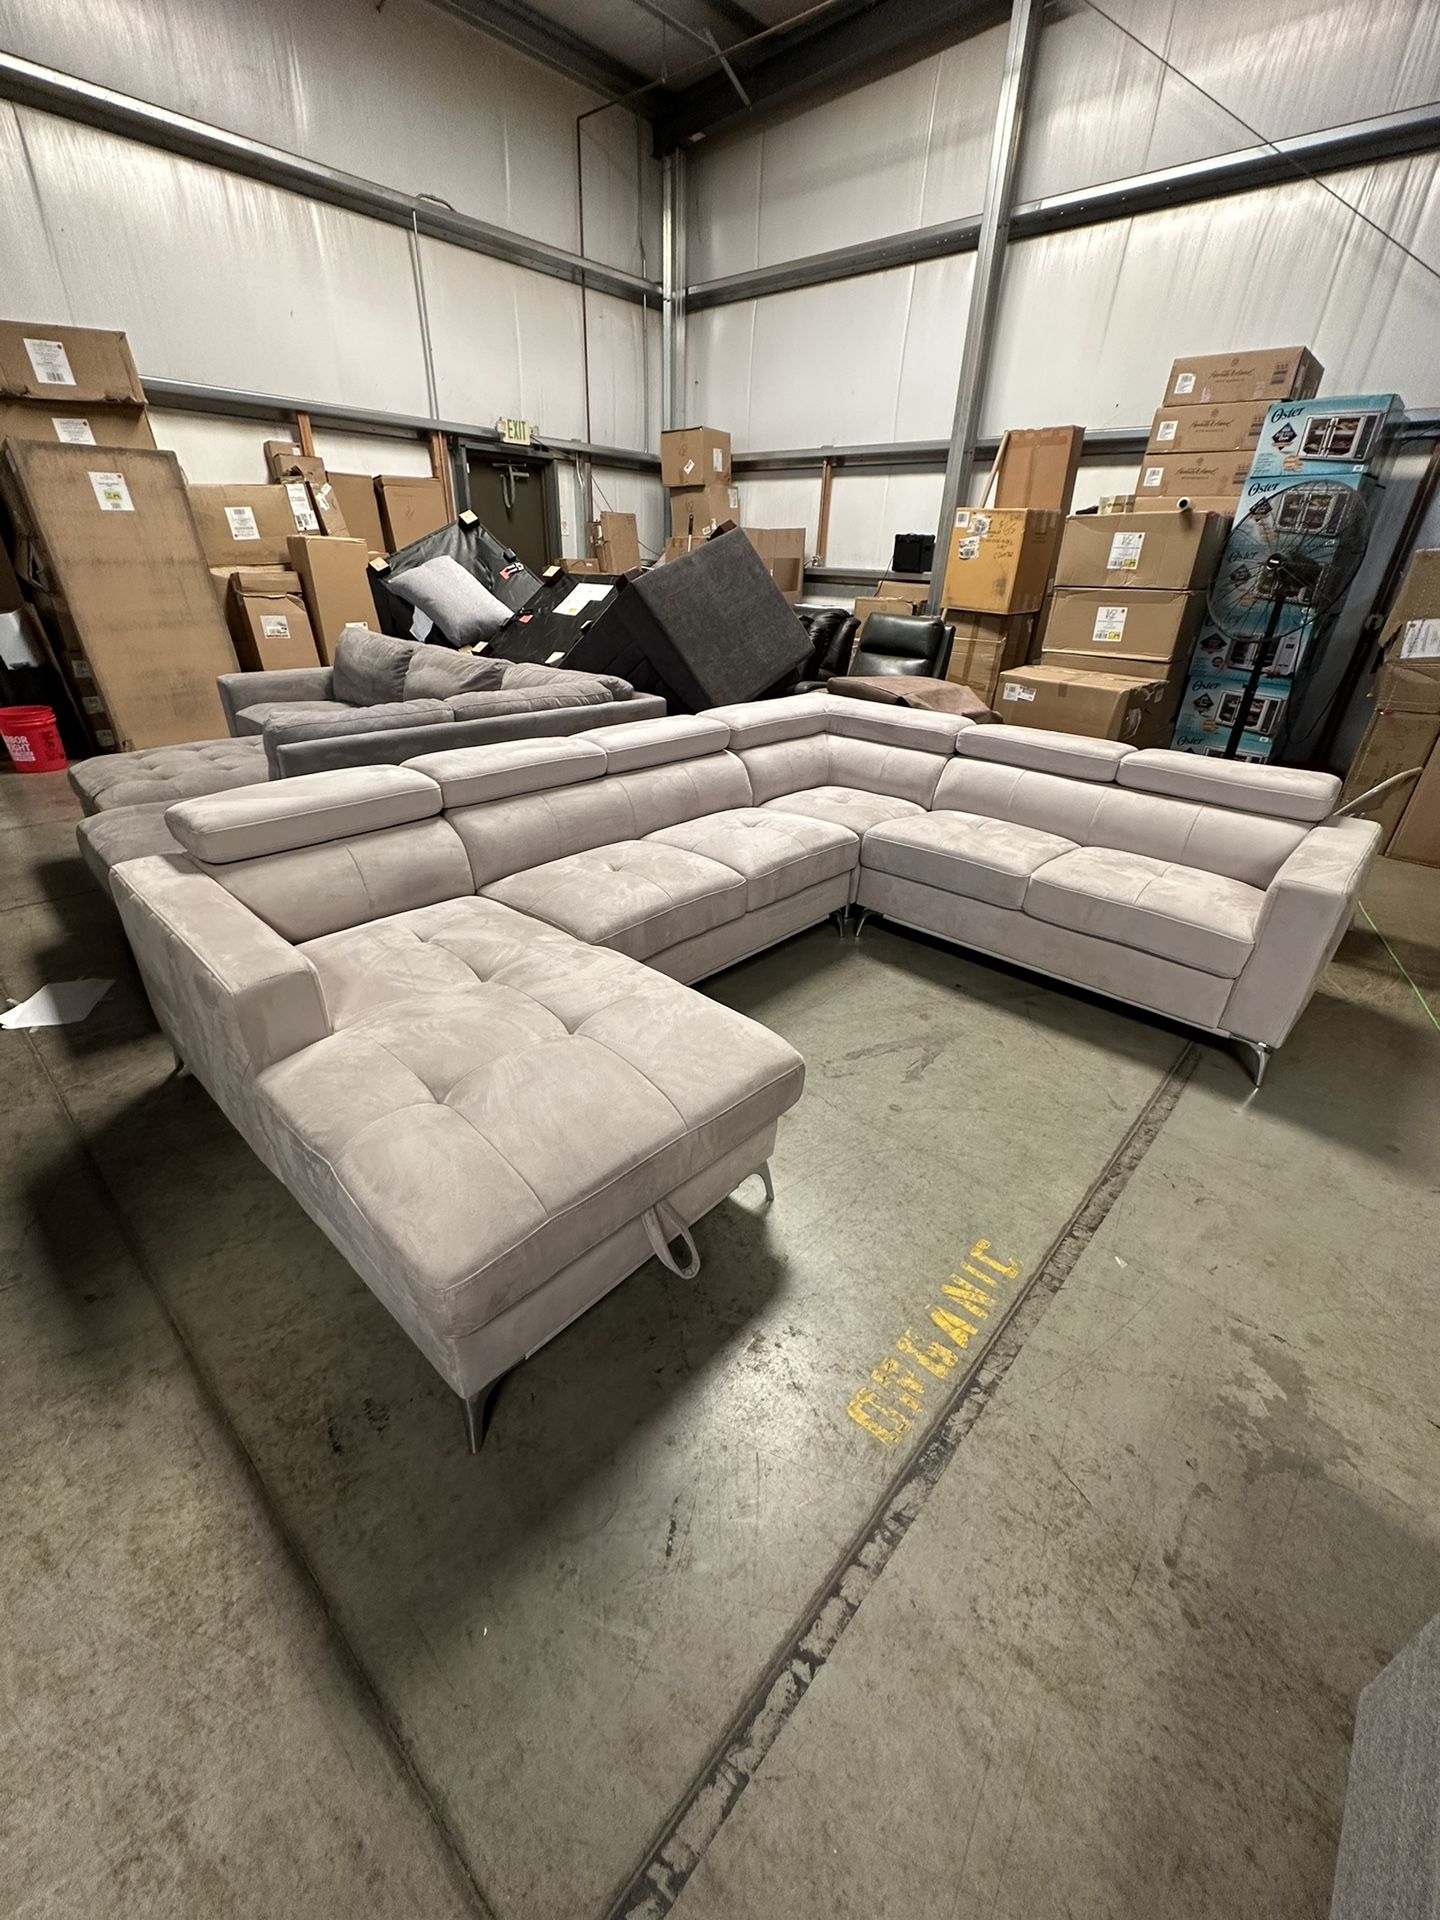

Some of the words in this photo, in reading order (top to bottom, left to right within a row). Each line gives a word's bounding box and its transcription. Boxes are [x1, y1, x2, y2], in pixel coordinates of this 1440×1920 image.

[1271, 406, 1305, 423] Oster
[507, 418, 527, 441] EXIT
[1248, 482, 1280, 497] Oster
[1192, 680, 1221, 691] Oster
[1177, 736, 1204, 745] Oster
[848, 1239, 1020, 1448] ORGANIC
